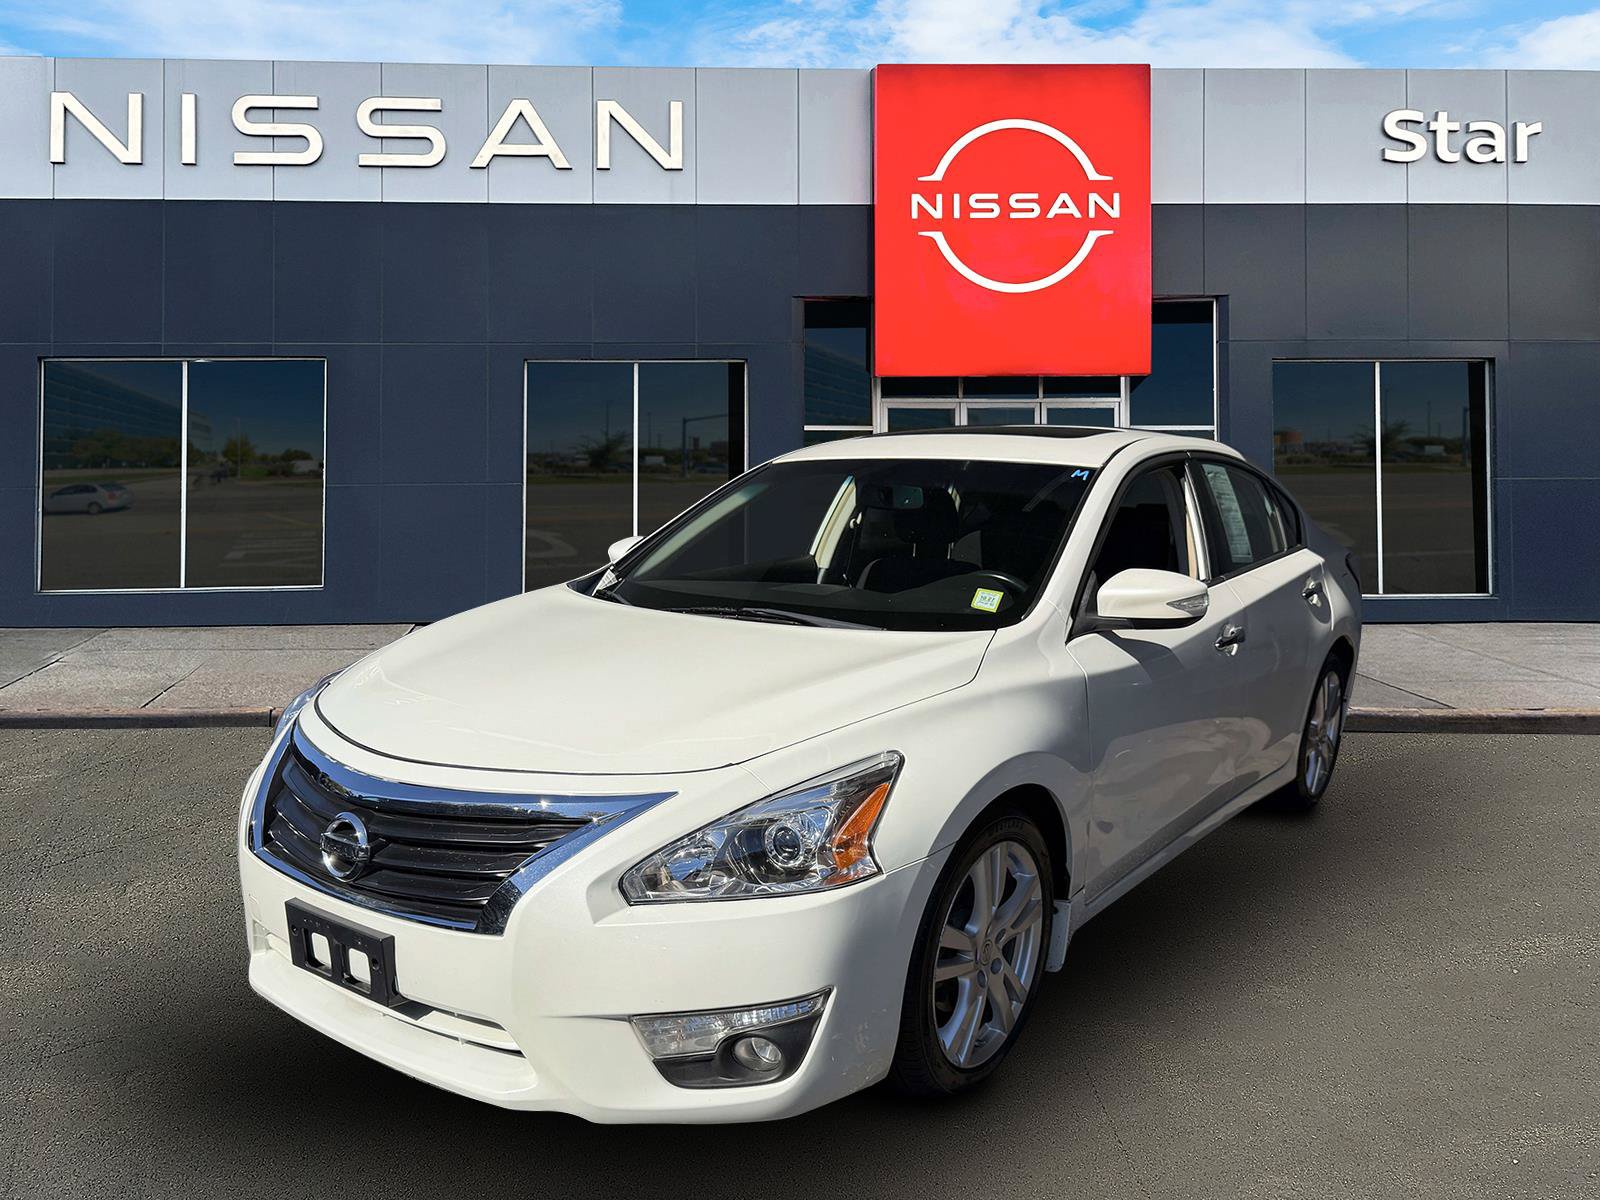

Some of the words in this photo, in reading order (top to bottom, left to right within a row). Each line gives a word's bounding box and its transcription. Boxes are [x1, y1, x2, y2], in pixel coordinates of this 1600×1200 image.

[49, 91, 684, 170] NISSAN
[1382, 108, 1542, 163] Star
[911, 193, 1120, 220] NISSAN
